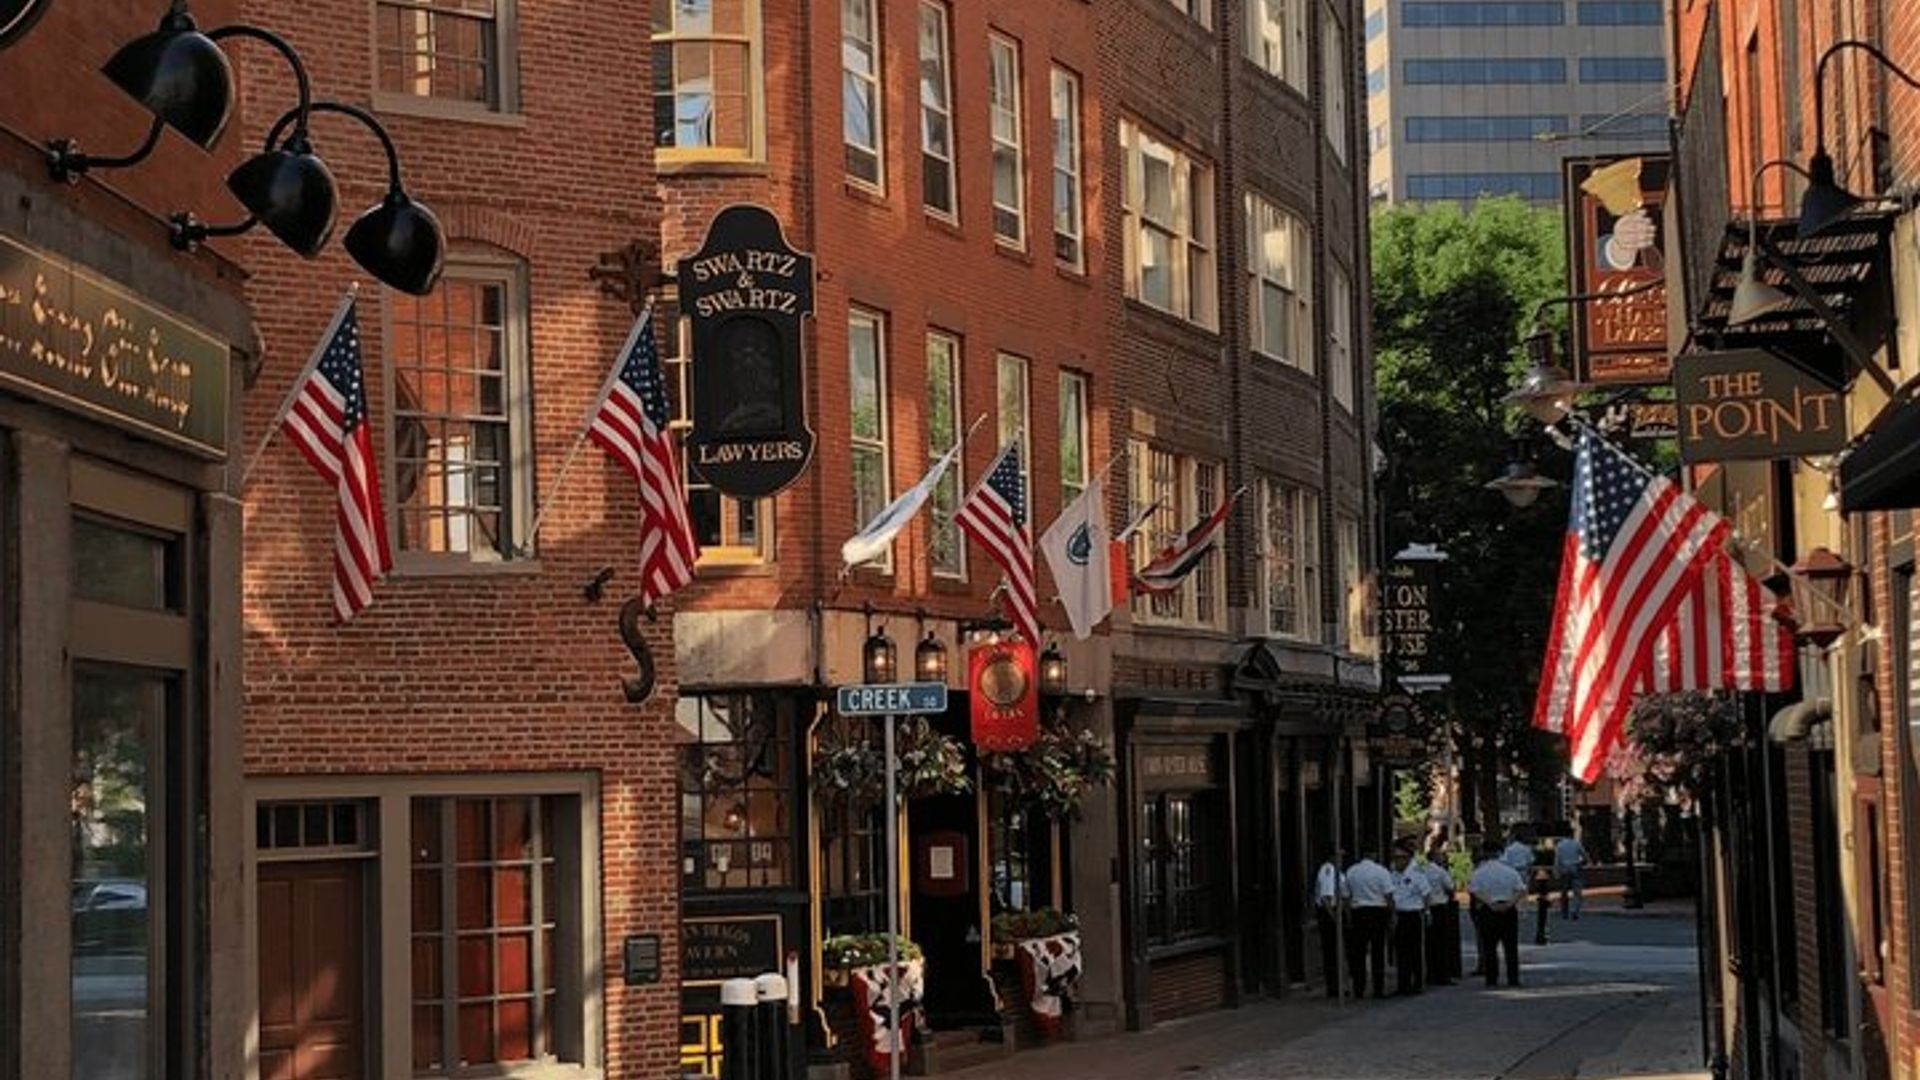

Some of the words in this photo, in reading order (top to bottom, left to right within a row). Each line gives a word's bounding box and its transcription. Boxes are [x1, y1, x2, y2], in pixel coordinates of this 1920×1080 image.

[692, 249, 797, 281] SWARTZ
[736, 270, 755, 289] &
[695, 288, 798, 318] SWARTZ
[1699, 371, 1764, 399] THE
[1686, 384, 1838, 445] POINT
[698, 440, 804, 464] LAWYERS
[848, 688, 911, 712] CREEK
